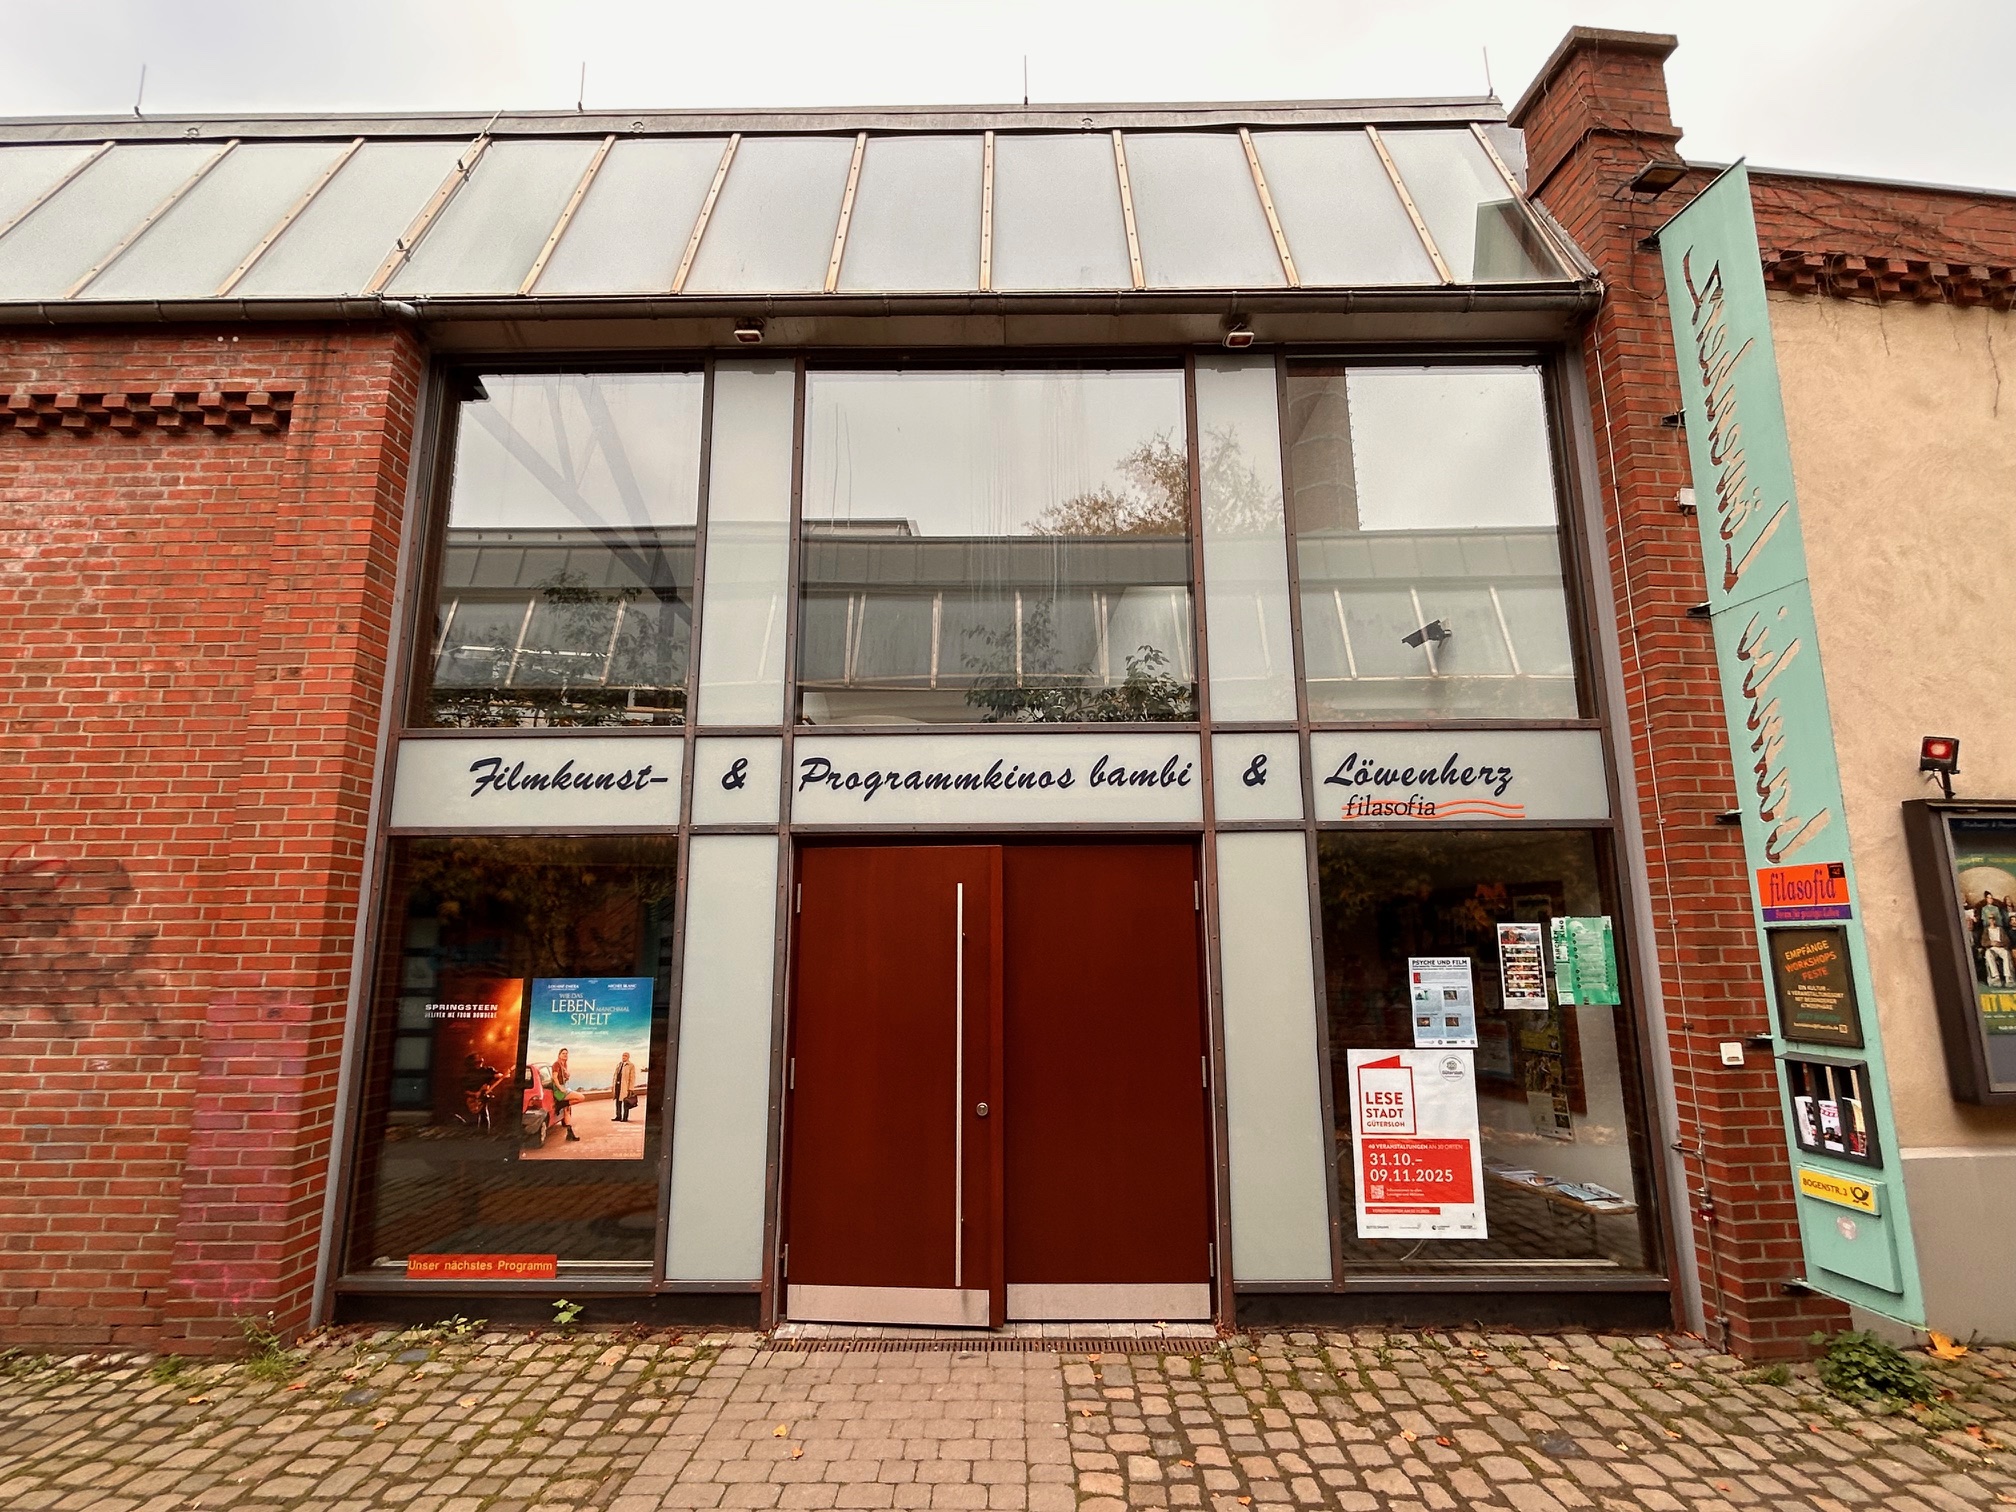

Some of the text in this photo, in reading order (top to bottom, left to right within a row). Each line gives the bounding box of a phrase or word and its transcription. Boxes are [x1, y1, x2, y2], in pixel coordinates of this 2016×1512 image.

[469, 752, 1513, 802] Filmkunst- & Programmkinos bambi & Löwenherz
[1346, 794, 1436, 817] filasofia
[1769, 869, 1836, 907] filasofia
[1784, 940, 1830, 960] EMPFÄNGE
[1784, 951, 1837, 973] WORKSHOPS
[1801, 966, 1829, 980] FESTE
[551, 999, 597, 1013] LEBEN
[570, 1012, 612, 1026] SPIELT
[1365, 1091, 1404, 1105] LESE
[1365, 1108, 1404, 1119] STADT
[1366, 1120, 1406, 1128] GÜTERSLOH
[1369, 1169, 1454, 1182] 09.11.2025
[408, 1260, 553, 1273] Unser nächstes Programm
